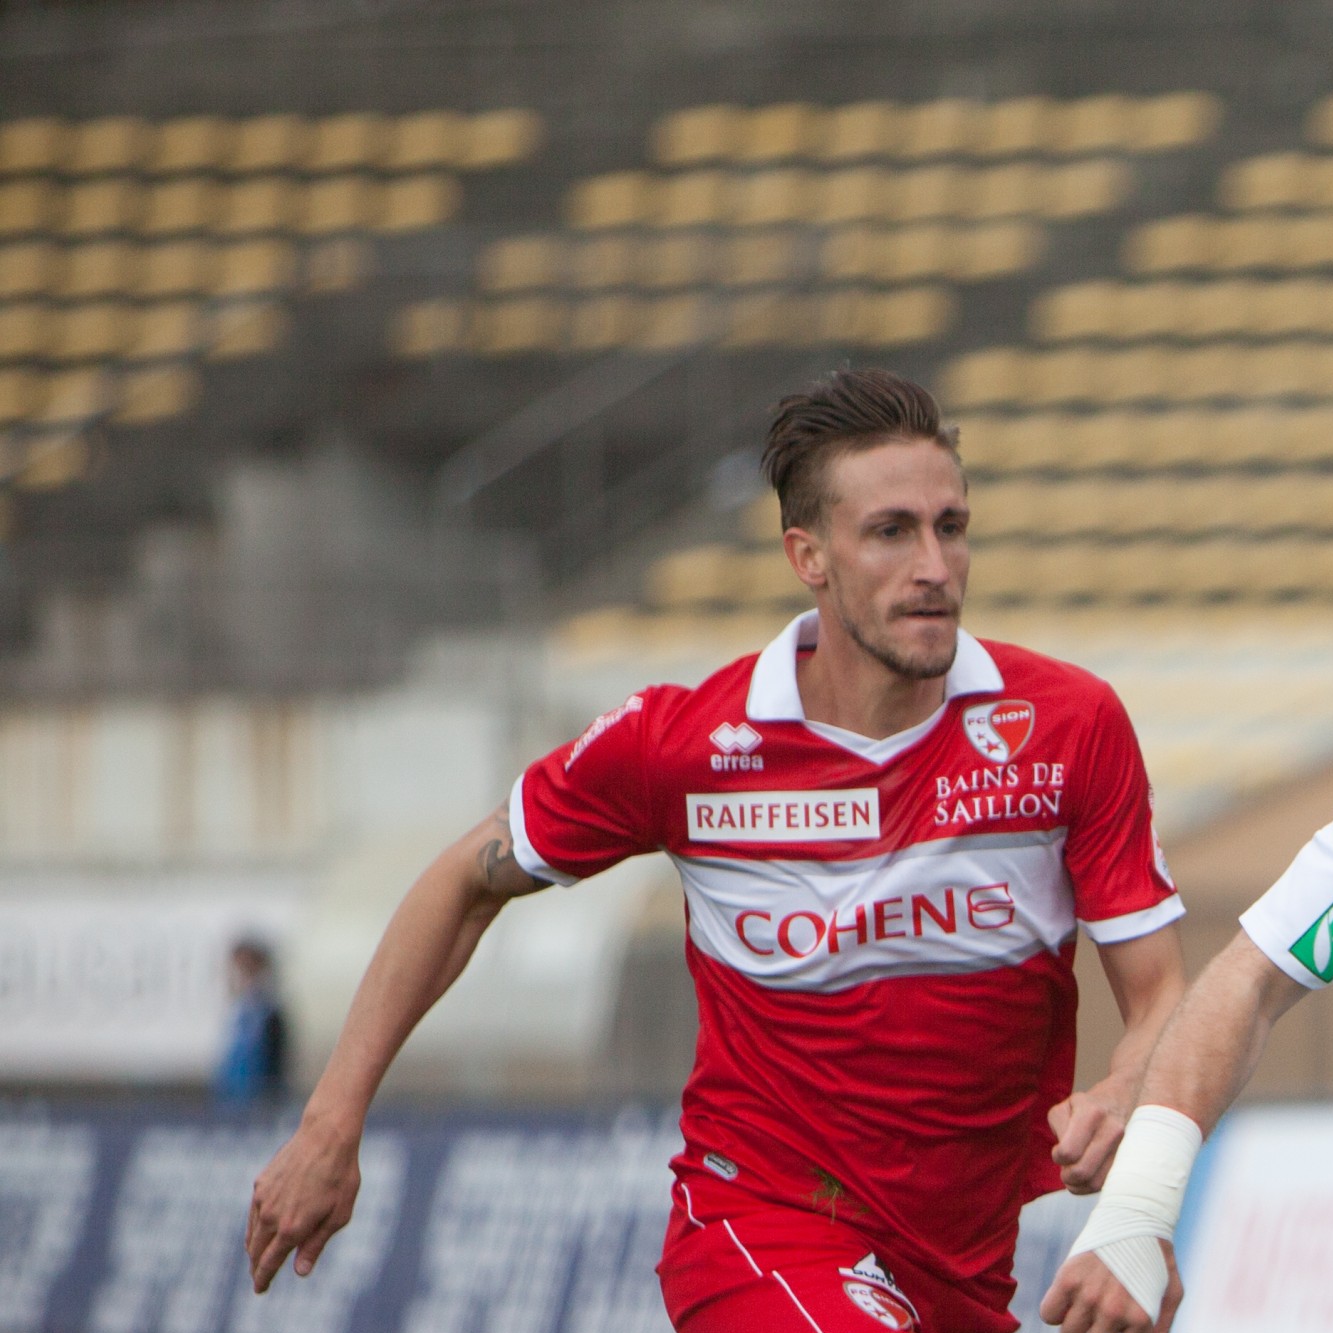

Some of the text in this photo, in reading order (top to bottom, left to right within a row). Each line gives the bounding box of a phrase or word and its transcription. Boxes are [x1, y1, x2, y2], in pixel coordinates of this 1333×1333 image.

[992, 709, 1030, 725] SION
[936, 762, 1064, 799] BAINS DE
[696, 801, 870, 828] RAIFFEISEN
[934, 790, 1062, 826] SAILLON
